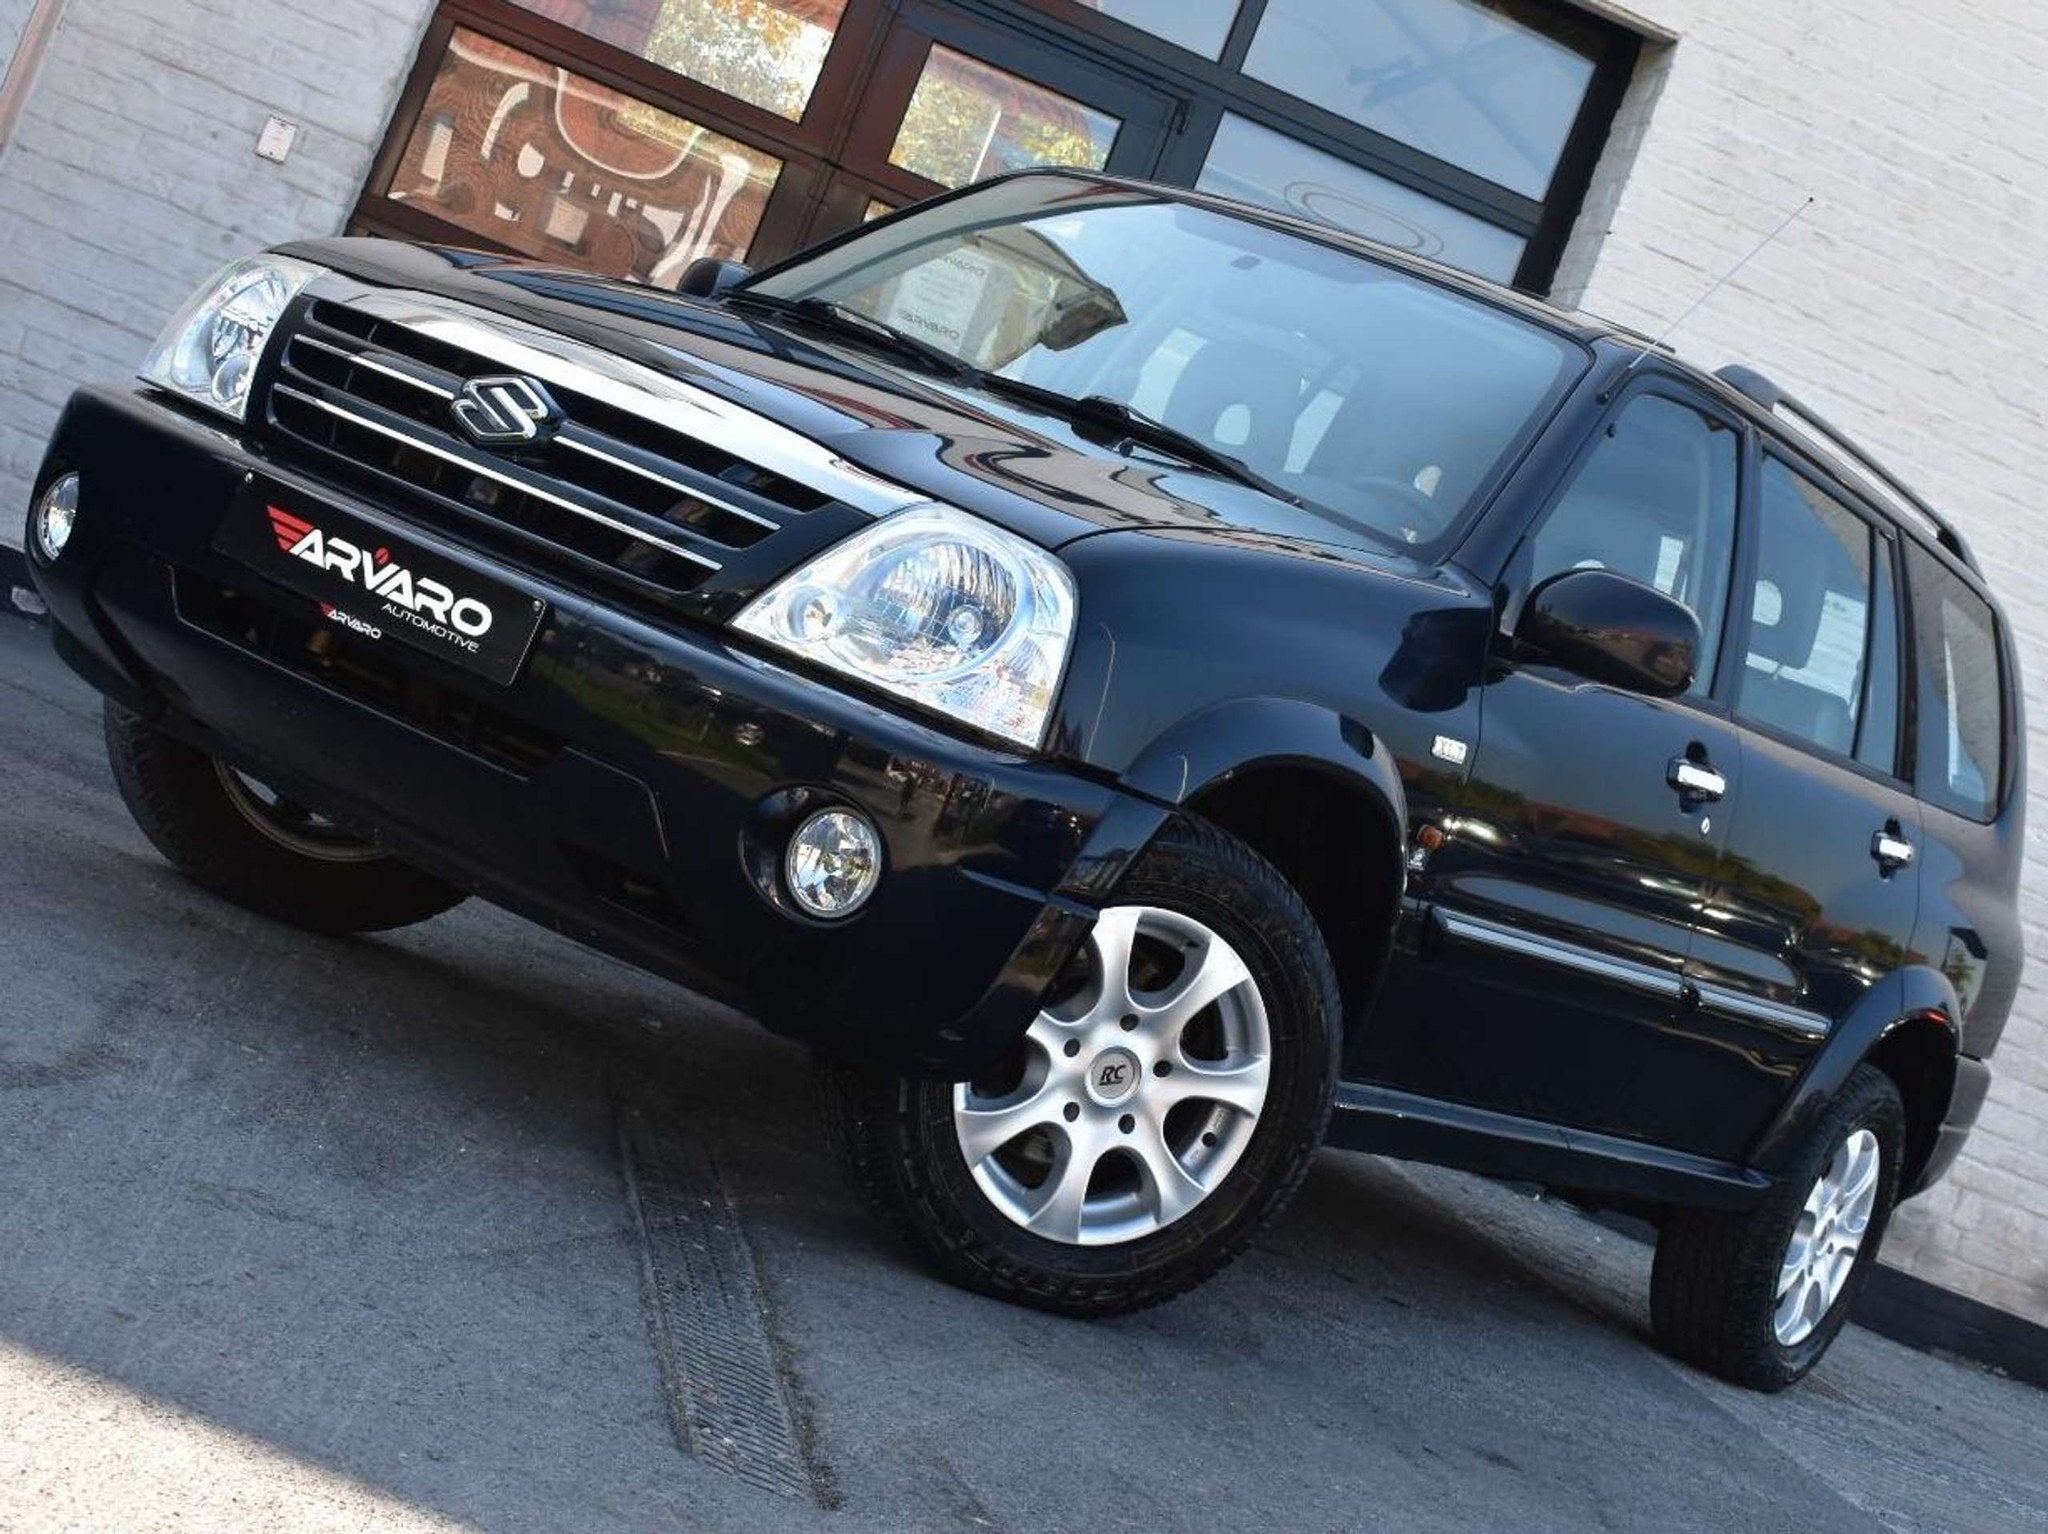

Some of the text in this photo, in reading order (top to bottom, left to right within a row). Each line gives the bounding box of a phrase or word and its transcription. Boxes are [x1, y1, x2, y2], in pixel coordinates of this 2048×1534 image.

[289, 528, 493, 638] ARVARO
[327, 609, 382, 640] ARVARO
[381, 602, 480, 654] AUTOMOTIVE
